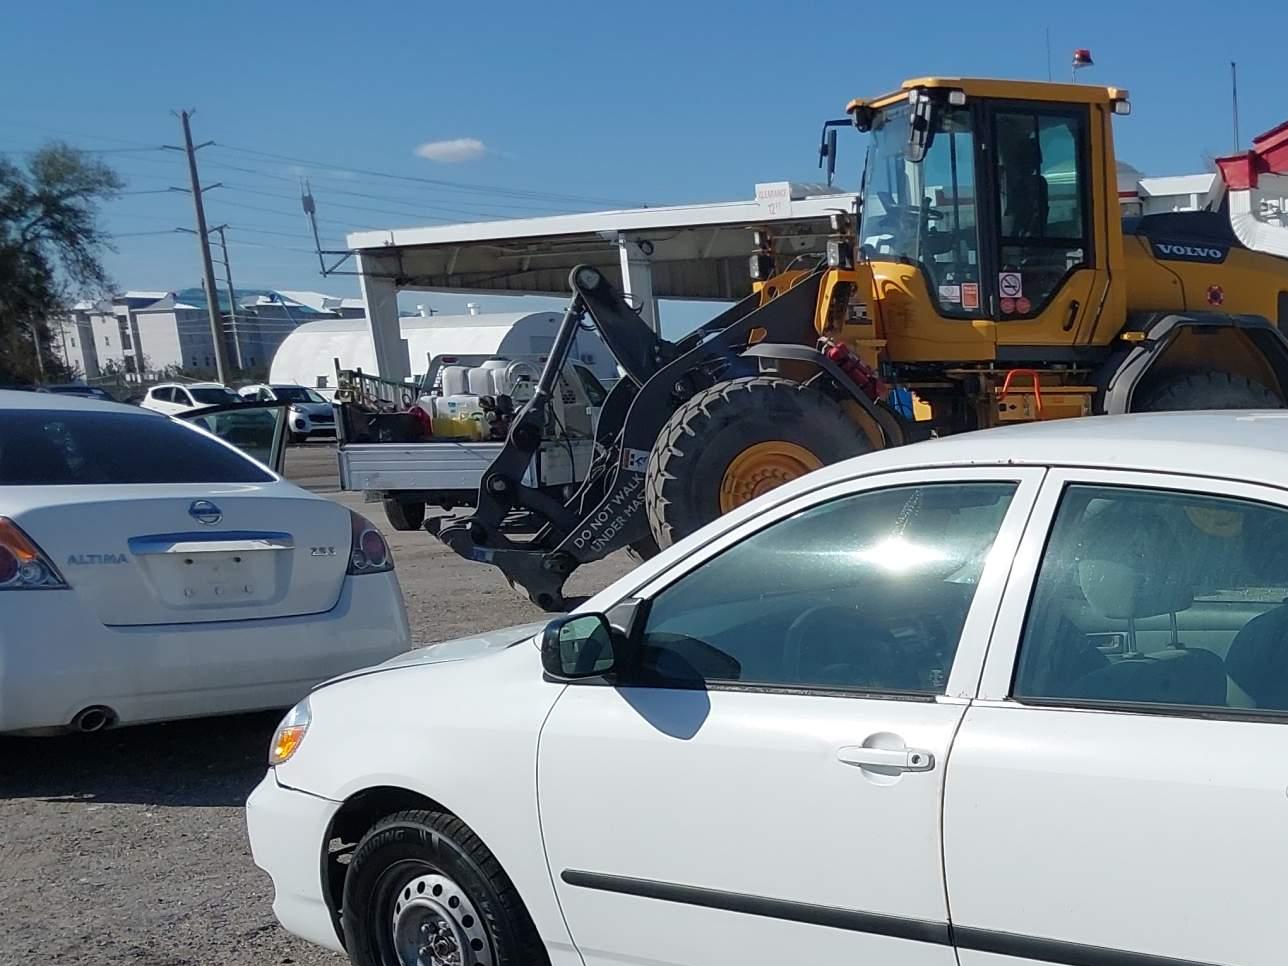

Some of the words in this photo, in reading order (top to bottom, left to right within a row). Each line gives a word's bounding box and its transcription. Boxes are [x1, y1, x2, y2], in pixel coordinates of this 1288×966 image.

[1156, 244, 1221, 258] VOLVO
[573, 529, 592, 548] DO
[591, 504, 614, 530] NOT
[613, 474, 643, 504] WALK
[591, 517, 625, 552] UNDER
[623, 488, 646, 517] MAS
[67, 553, 129, 566] ALTIMA
